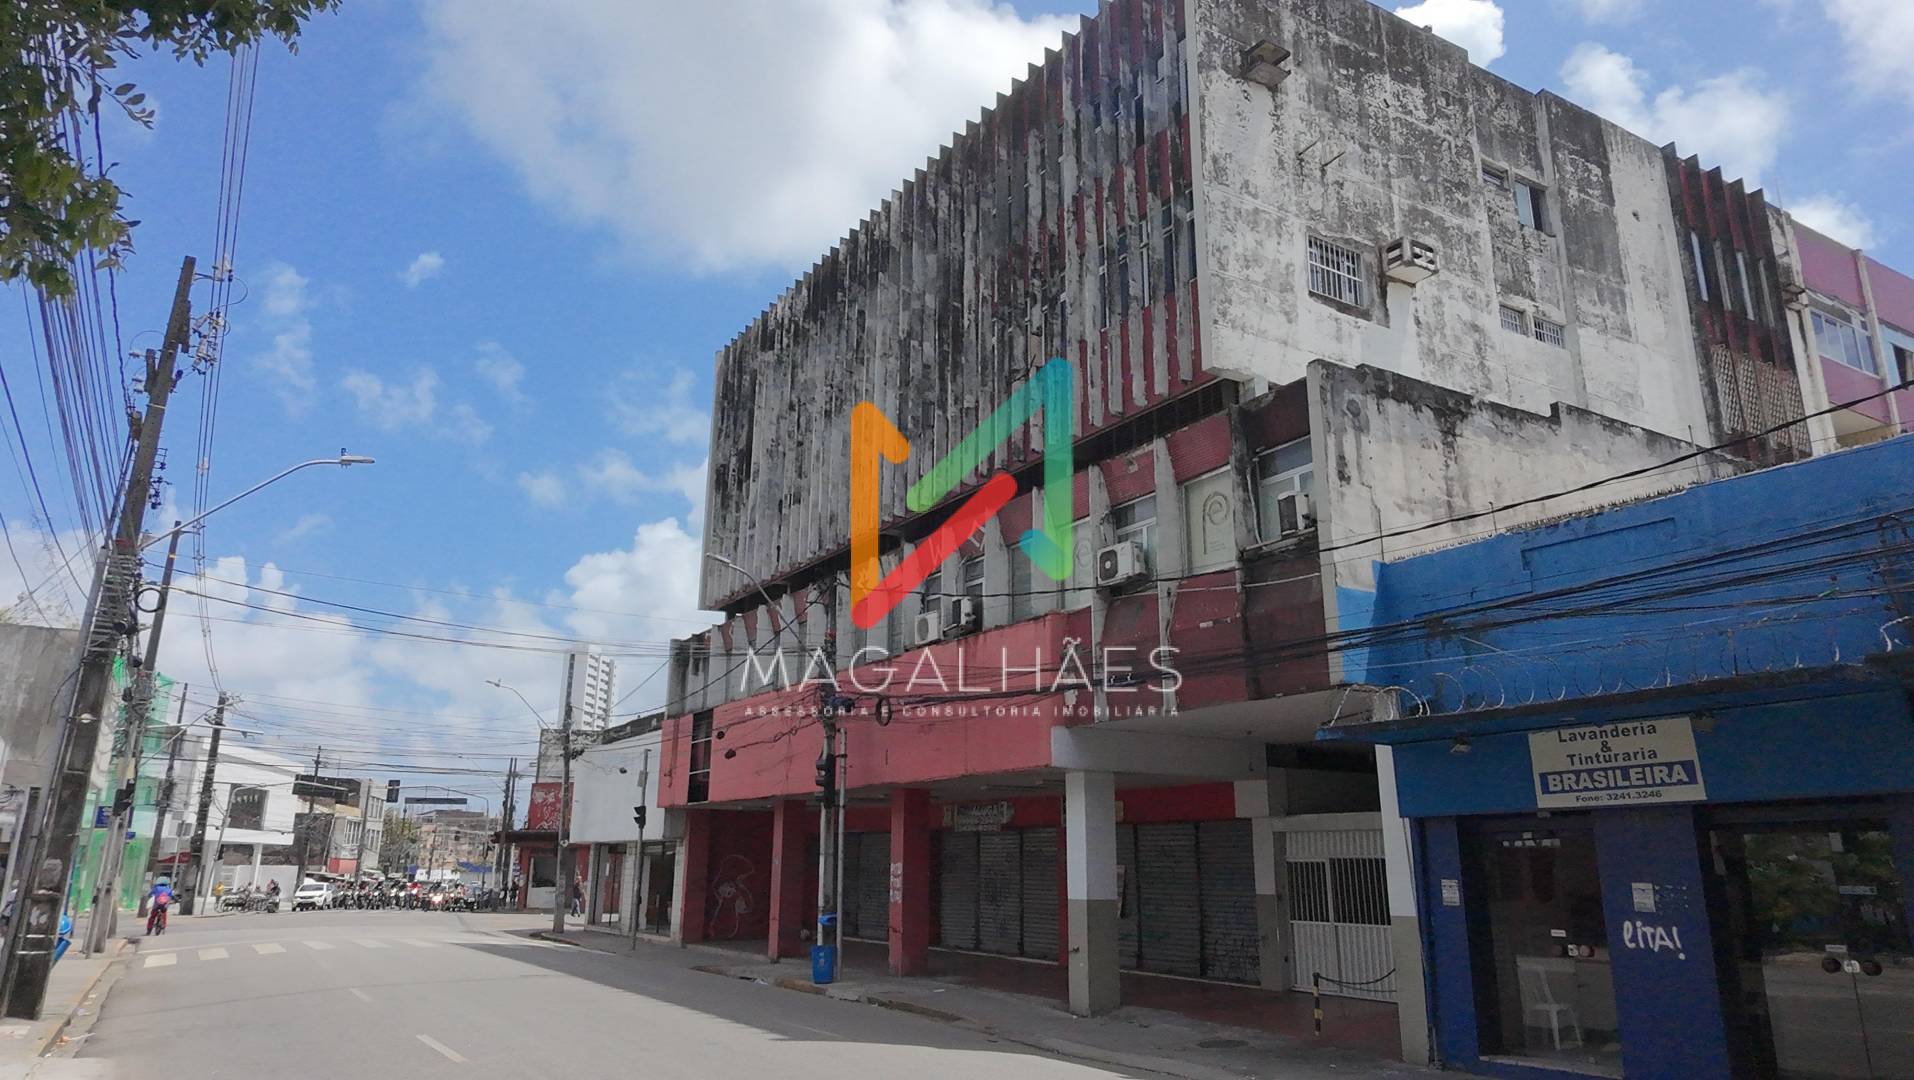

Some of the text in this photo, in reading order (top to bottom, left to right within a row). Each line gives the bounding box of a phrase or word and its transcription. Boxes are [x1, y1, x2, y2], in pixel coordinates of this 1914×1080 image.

[1557, 722, 1657, 743] Lavanderia
[1600, 740, 1613, 753] &
[1566, 748, 1659, 767] Tinturaria
[1547, 764, 1690, 793] BRASILEIRA
[1575, 794, 1603, 803] Fone:
